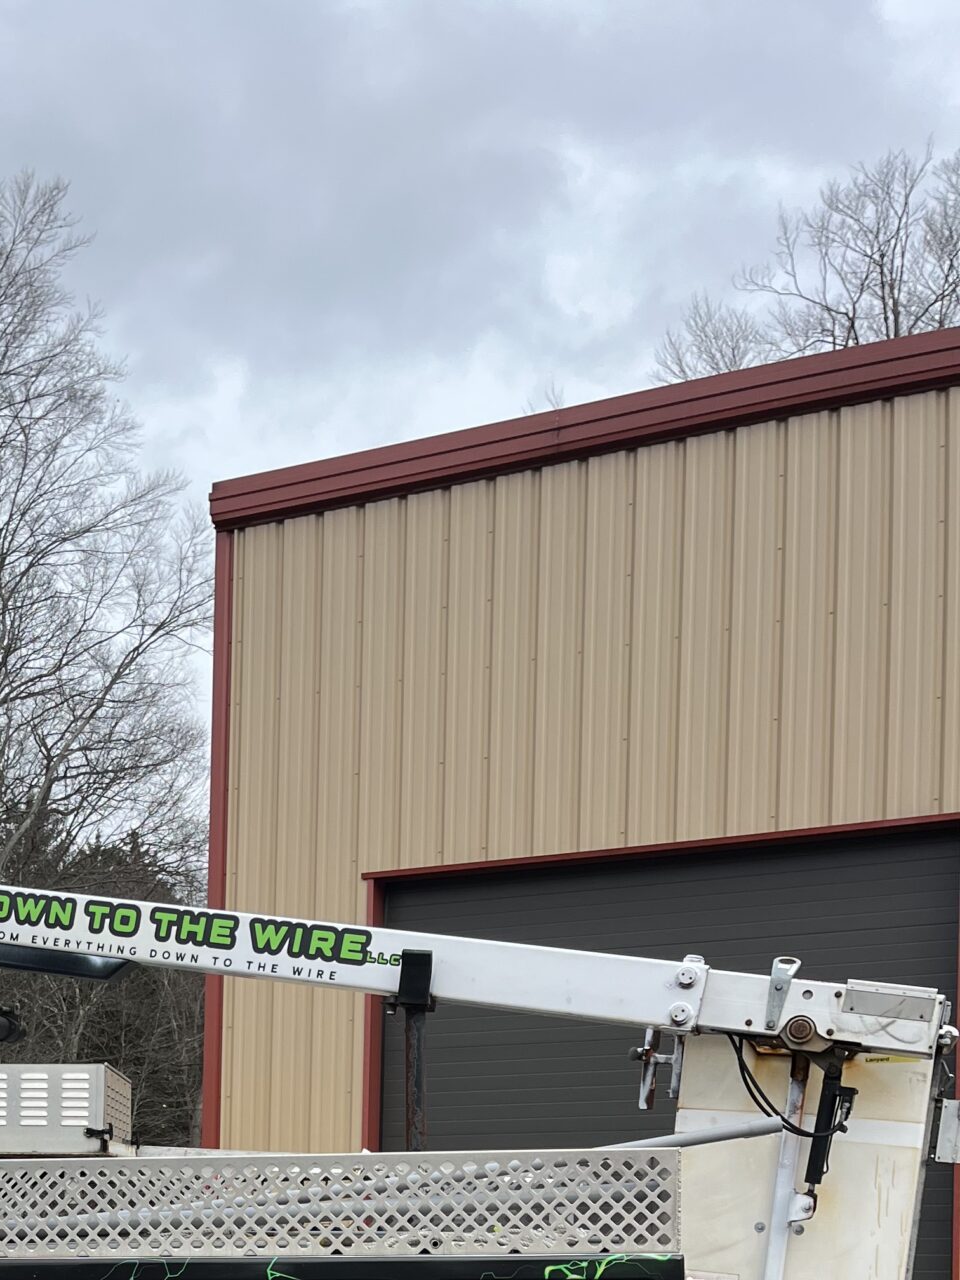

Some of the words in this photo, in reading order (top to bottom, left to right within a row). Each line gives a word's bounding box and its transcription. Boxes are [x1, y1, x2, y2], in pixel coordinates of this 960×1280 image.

[31, 935, 137, 956] EVERYTHING
[149, 948, 199, 964] DOWN
[212, 956, 233, 968] TO
[247, 960, 279, 974] THE
[292, 966, 337, 981] WIRE
[84, 899, 141, 937] TO
[150, 906, 239, 950] THE
[249, 917, 372, 965] WIRE
[366, 950, 402, 967] LLC
